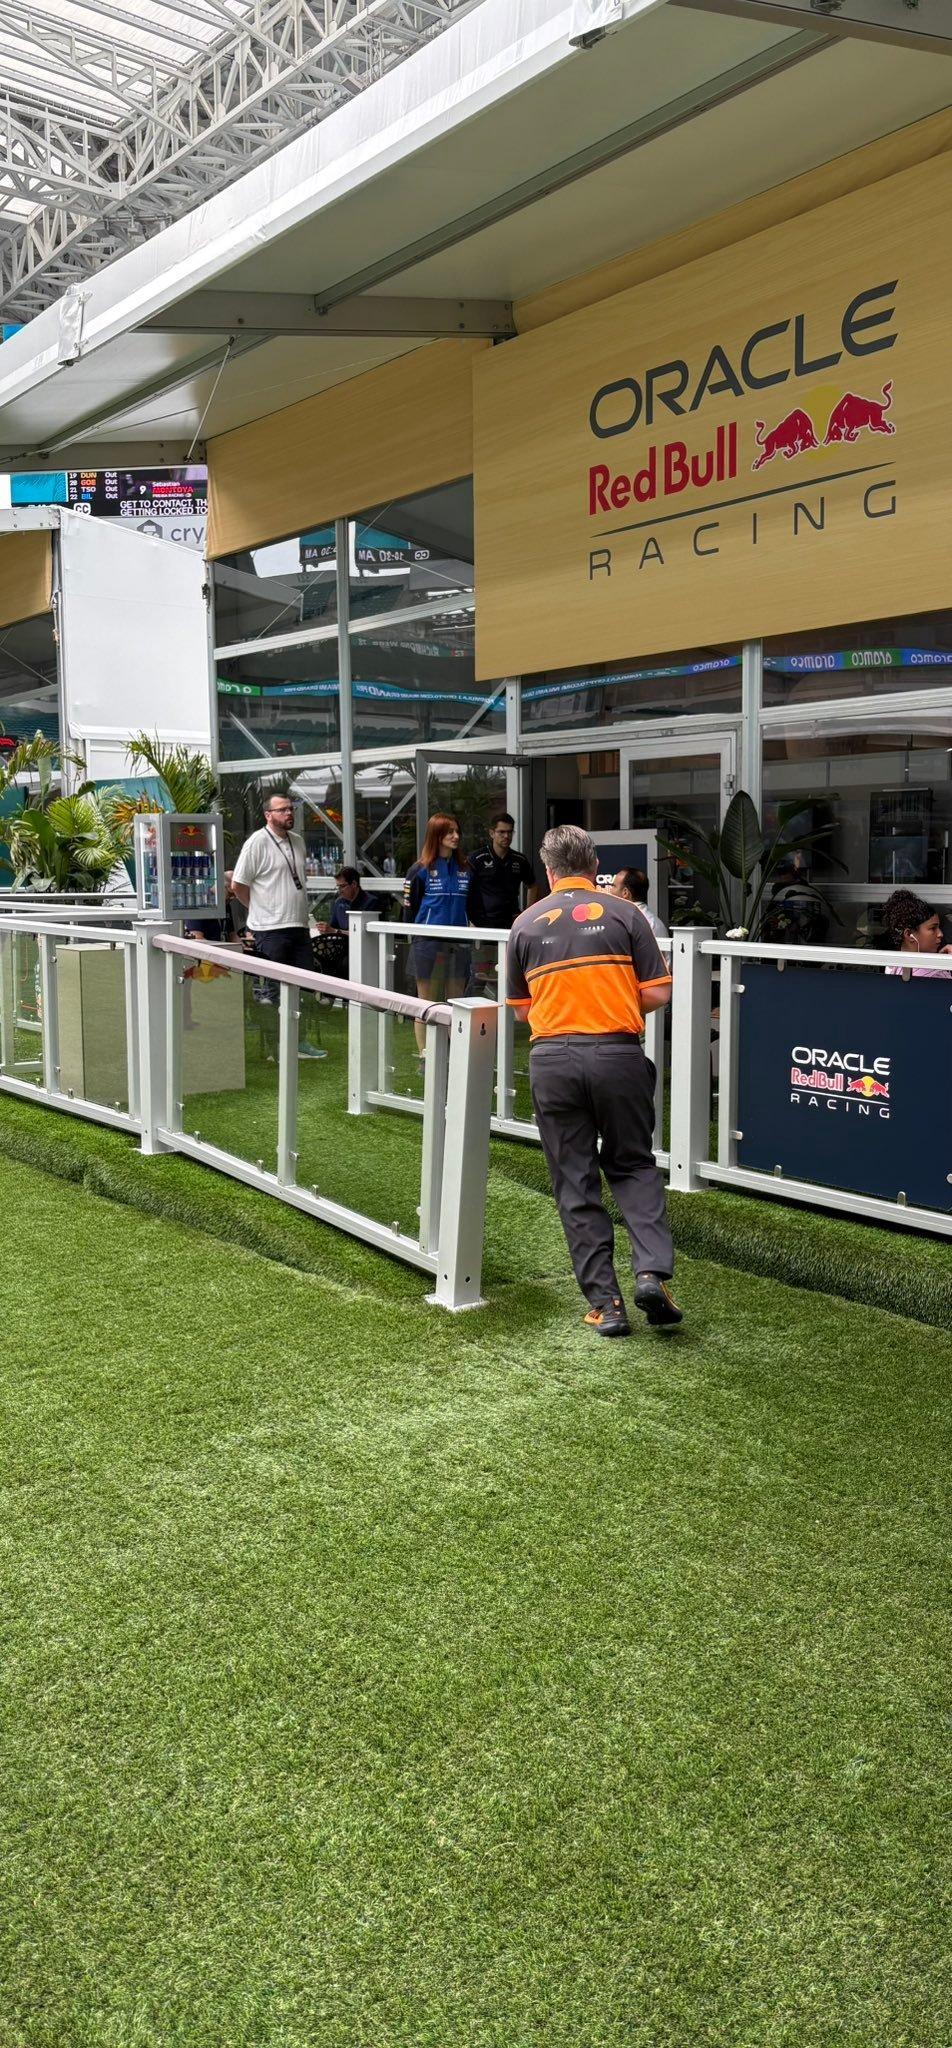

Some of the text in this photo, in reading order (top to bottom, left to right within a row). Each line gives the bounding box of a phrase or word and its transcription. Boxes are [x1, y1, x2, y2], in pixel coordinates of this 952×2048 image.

[589, 279, 899, 439] ORACLE
[588, 422, 738, 516] Red Bull
[140, 485, 147, 495] 9
[120, 500, 137, 509] GET
[139, 500, 151, 508] TO
[120, 508, 158, 517] GETTING
[160, 507, 194, 515] LOCKED
[170, 526, 205, 544] cry
[589, 480, 897, 581] RACING
[791, 1046, 891, 1076] ORACLE
[791, 1067, 844, 1092] Red Bull
[790, 1093, 890, 1119] RACING
